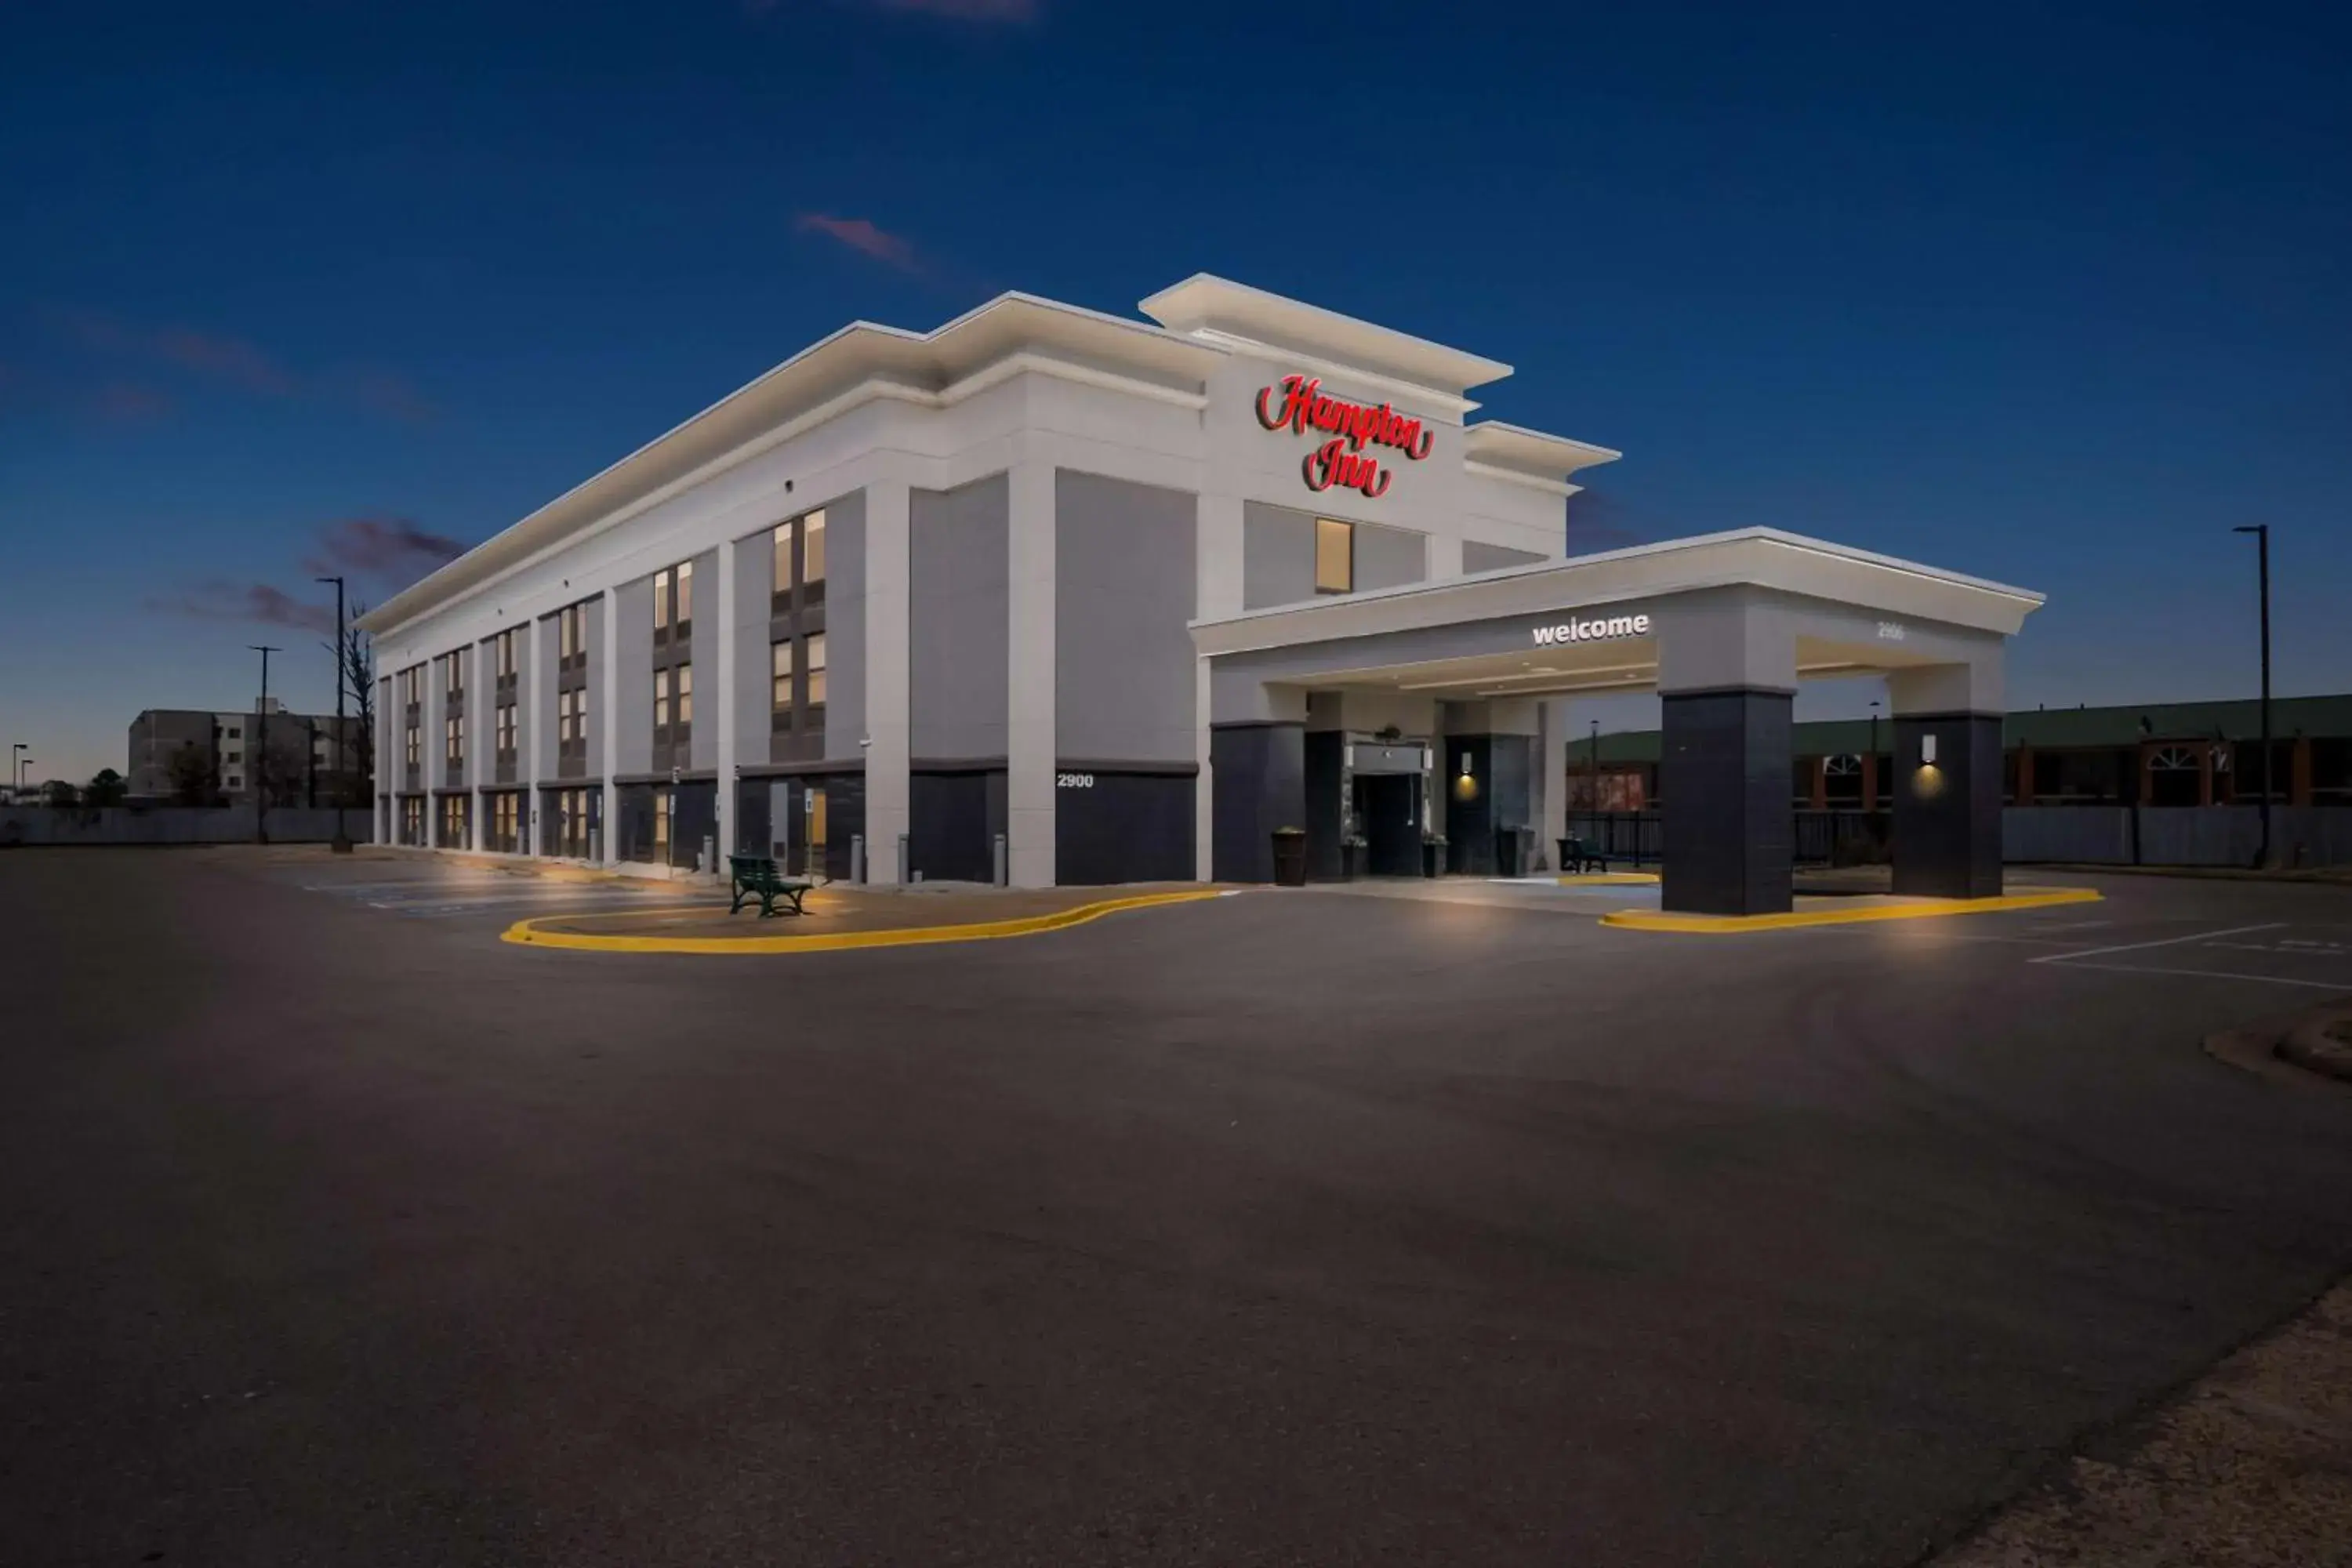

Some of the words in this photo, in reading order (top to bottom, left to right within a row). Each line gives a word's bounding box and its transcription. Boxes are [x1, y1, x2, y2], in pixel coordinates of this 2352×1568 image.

[1256, 374, 1434, 459] Hampton
[1301, 437, 1392, 498] Inn
[1533, 614, 1649, 644] welcome
[1058, 773, 1094, 787] 2900
